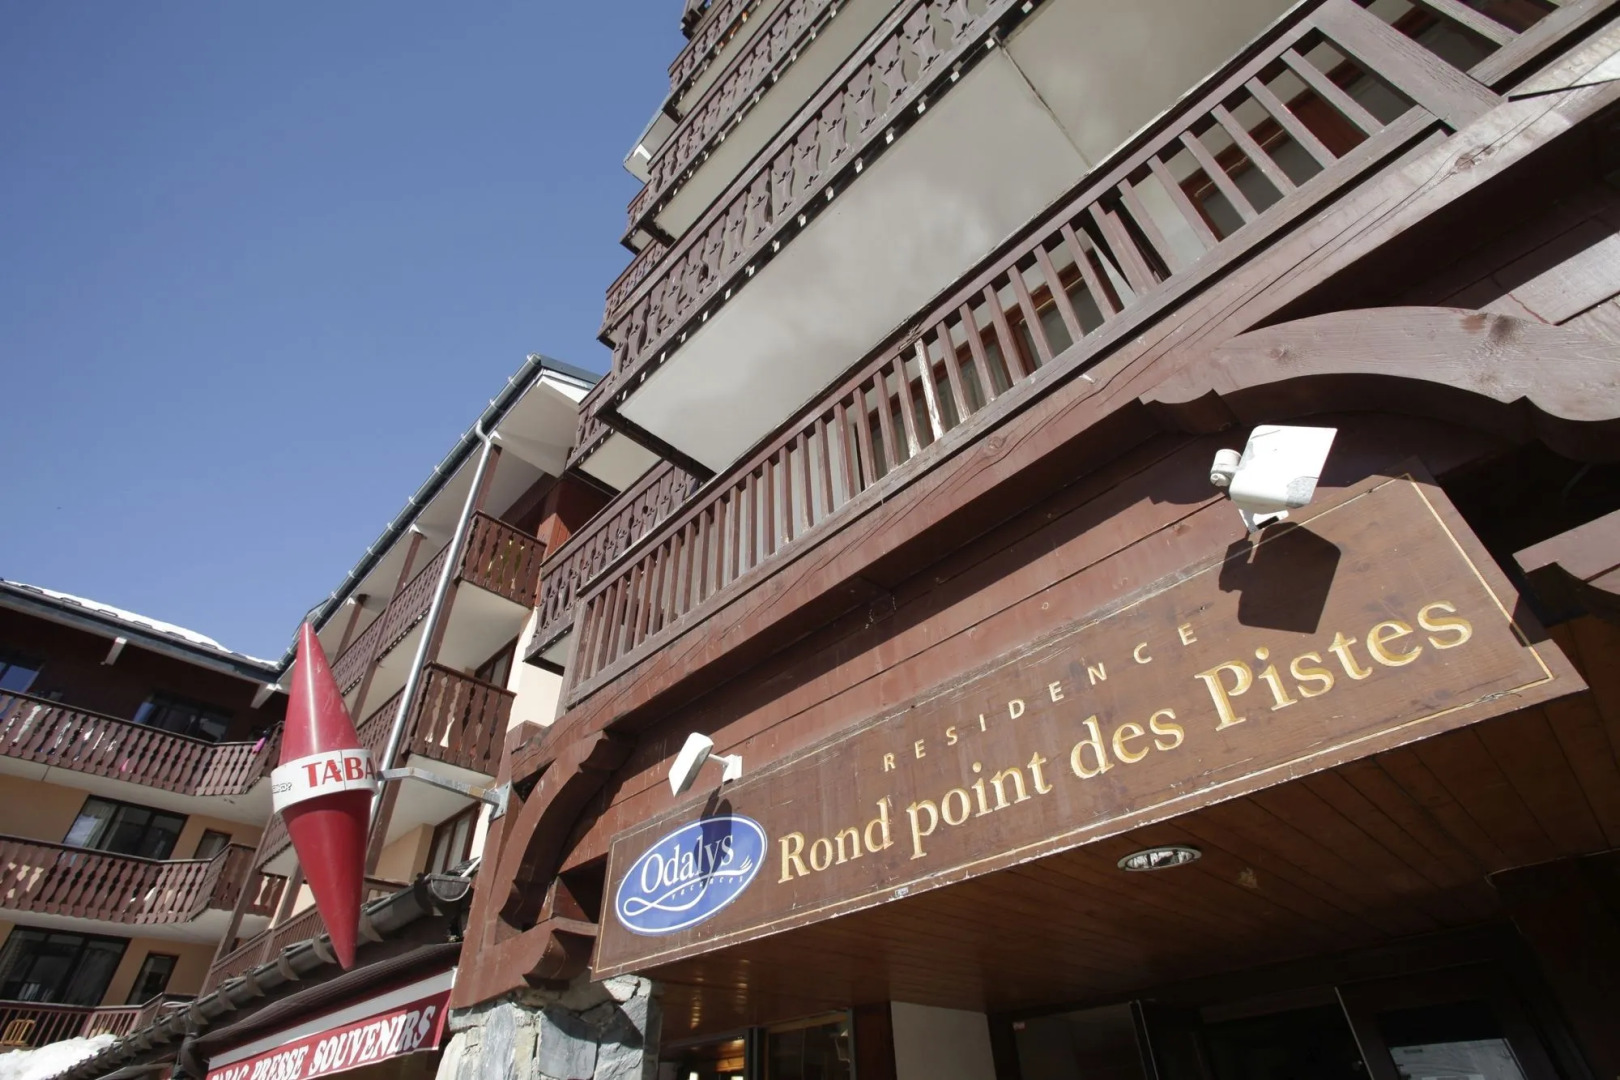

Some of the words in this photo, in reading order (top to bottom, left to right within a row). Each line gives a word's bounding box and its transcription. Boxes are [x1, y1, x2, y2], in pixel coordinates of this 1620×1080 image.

[778, 796, 894, 884] Rond
[906, 751, 1053, 860] point
[1070, 708, 1185, 780] des
[1194, 600, 1473, 731] Pistes
[883, 622, 1197, 771] RESIDENCE
[641, 834, 734, 894] Odalys
[250, 1045, 309, 1080] PRESSE
[308, 1005, 436, 1073] SOUVENIRS
